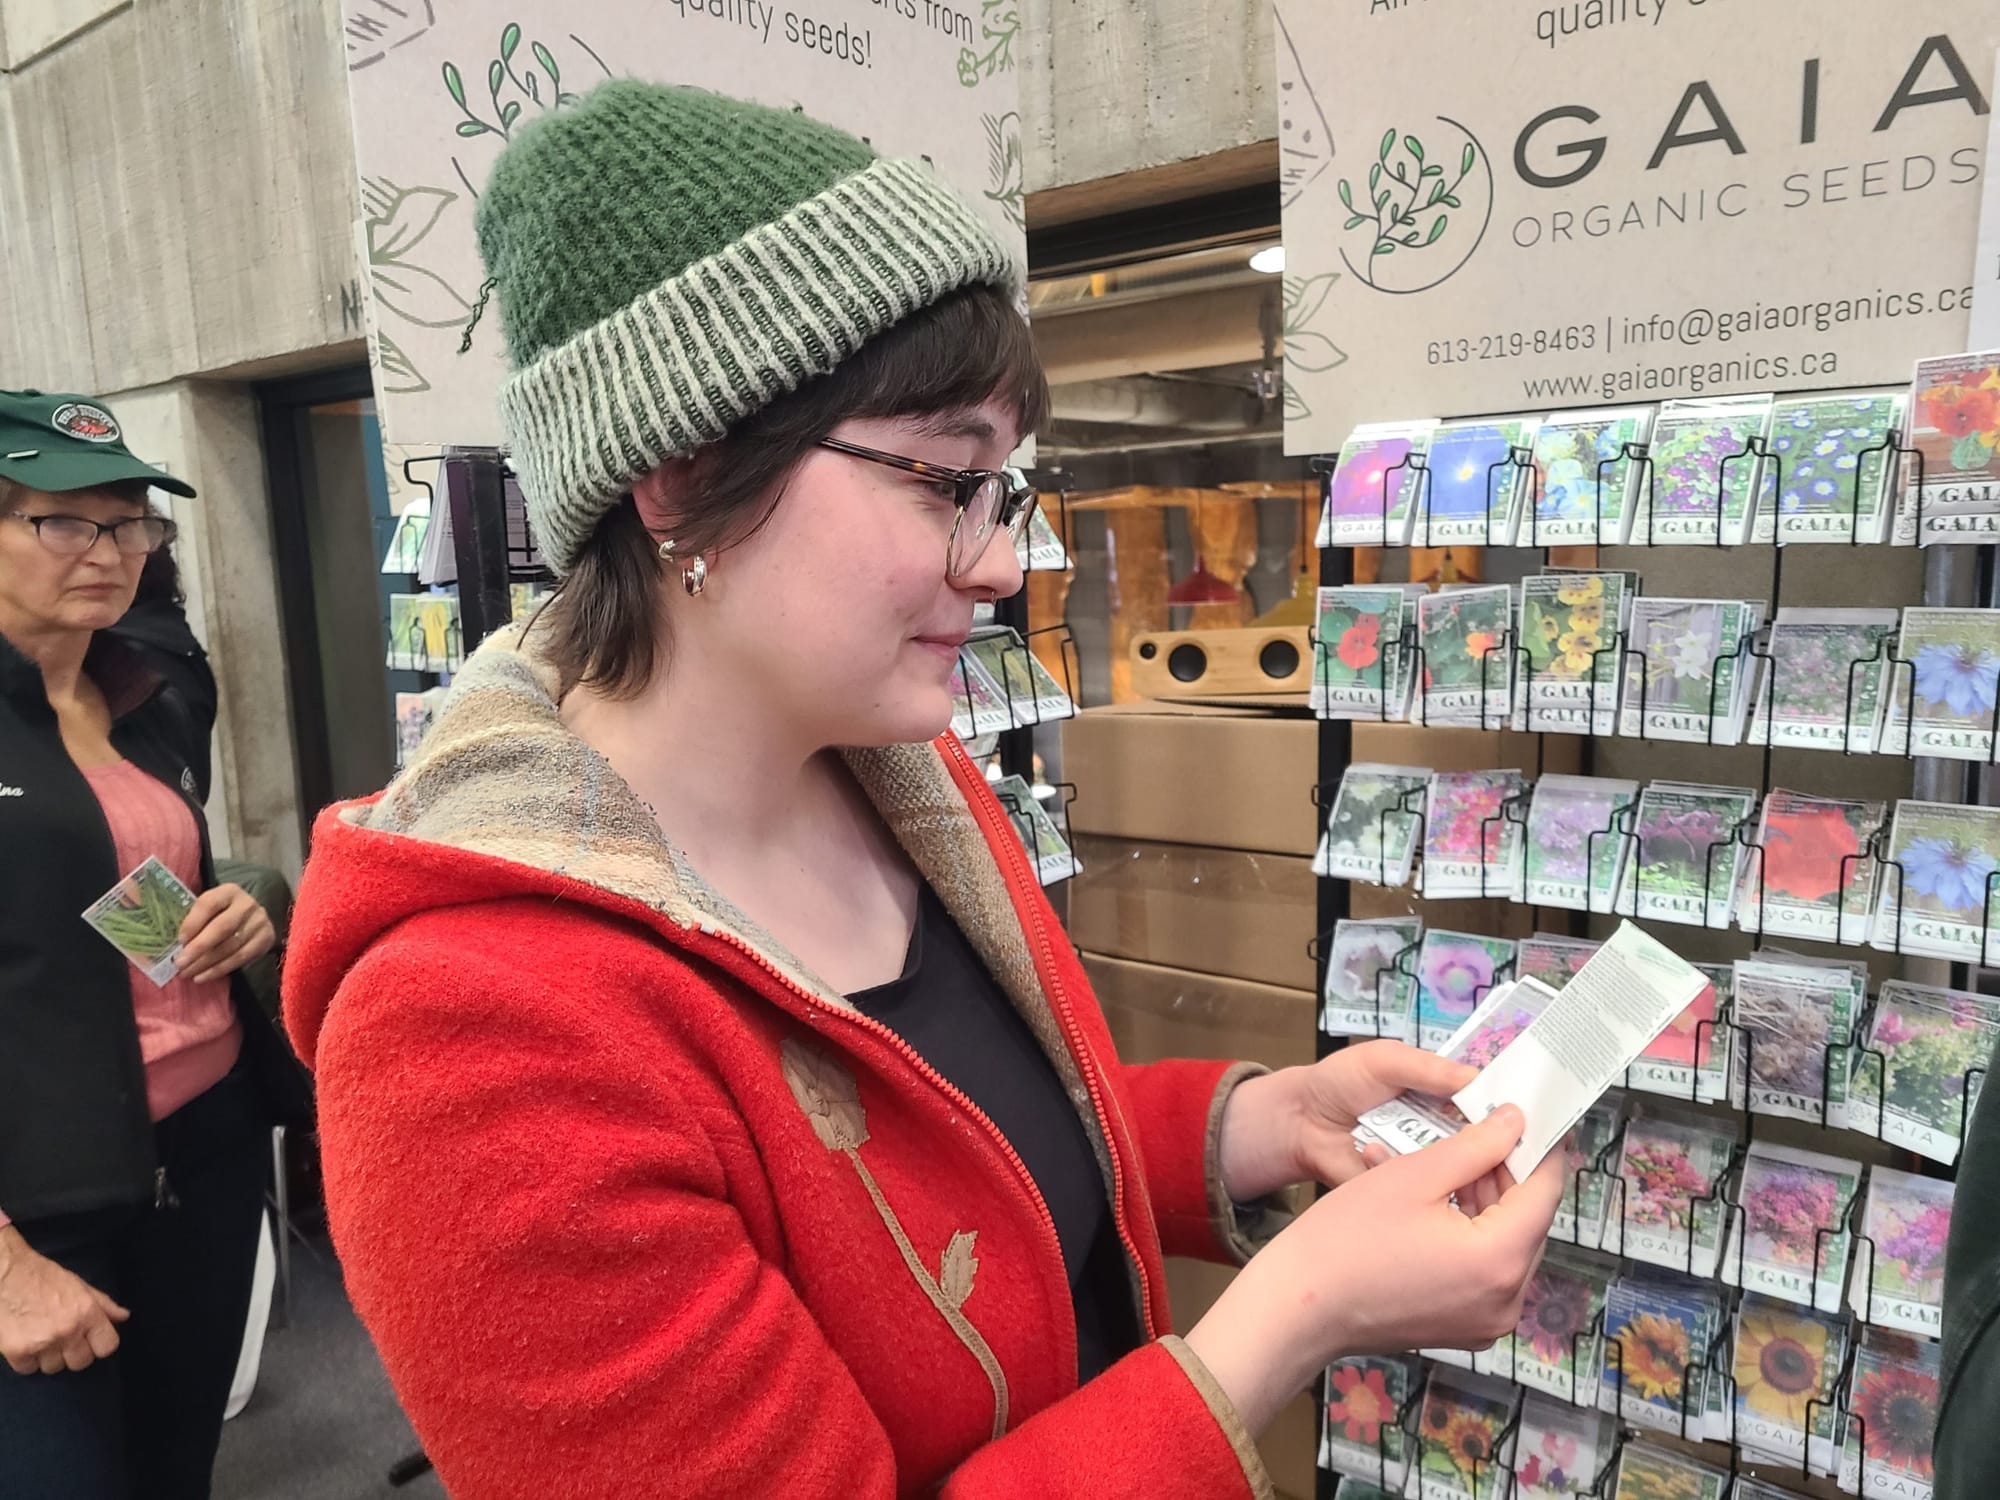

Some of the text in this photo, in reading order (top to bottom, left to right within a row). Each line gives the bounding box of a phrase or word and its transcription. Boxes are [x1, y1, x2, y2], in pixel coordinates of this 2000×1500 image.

[784, 11, 873, 69] seeds!
[1513, 34, 1990, 188] GAIA
[1512, 147, 1980, 247] ORGANIC SEEDS
[1427, 324, 1596, 365] 613-219-8463
[1623, 286, 1974, 346] info@gaiaorganics.ca
[1522, 351, 1838, 400] www.gaiaorganics.ca
[1784, 516, 1850, 531] GAIA
[1926, 516, 1999, 532] GAIA
[1761, 1091, 1823, 1115] GAIA
[1627, 1399, 1682, 1427] GAIA
